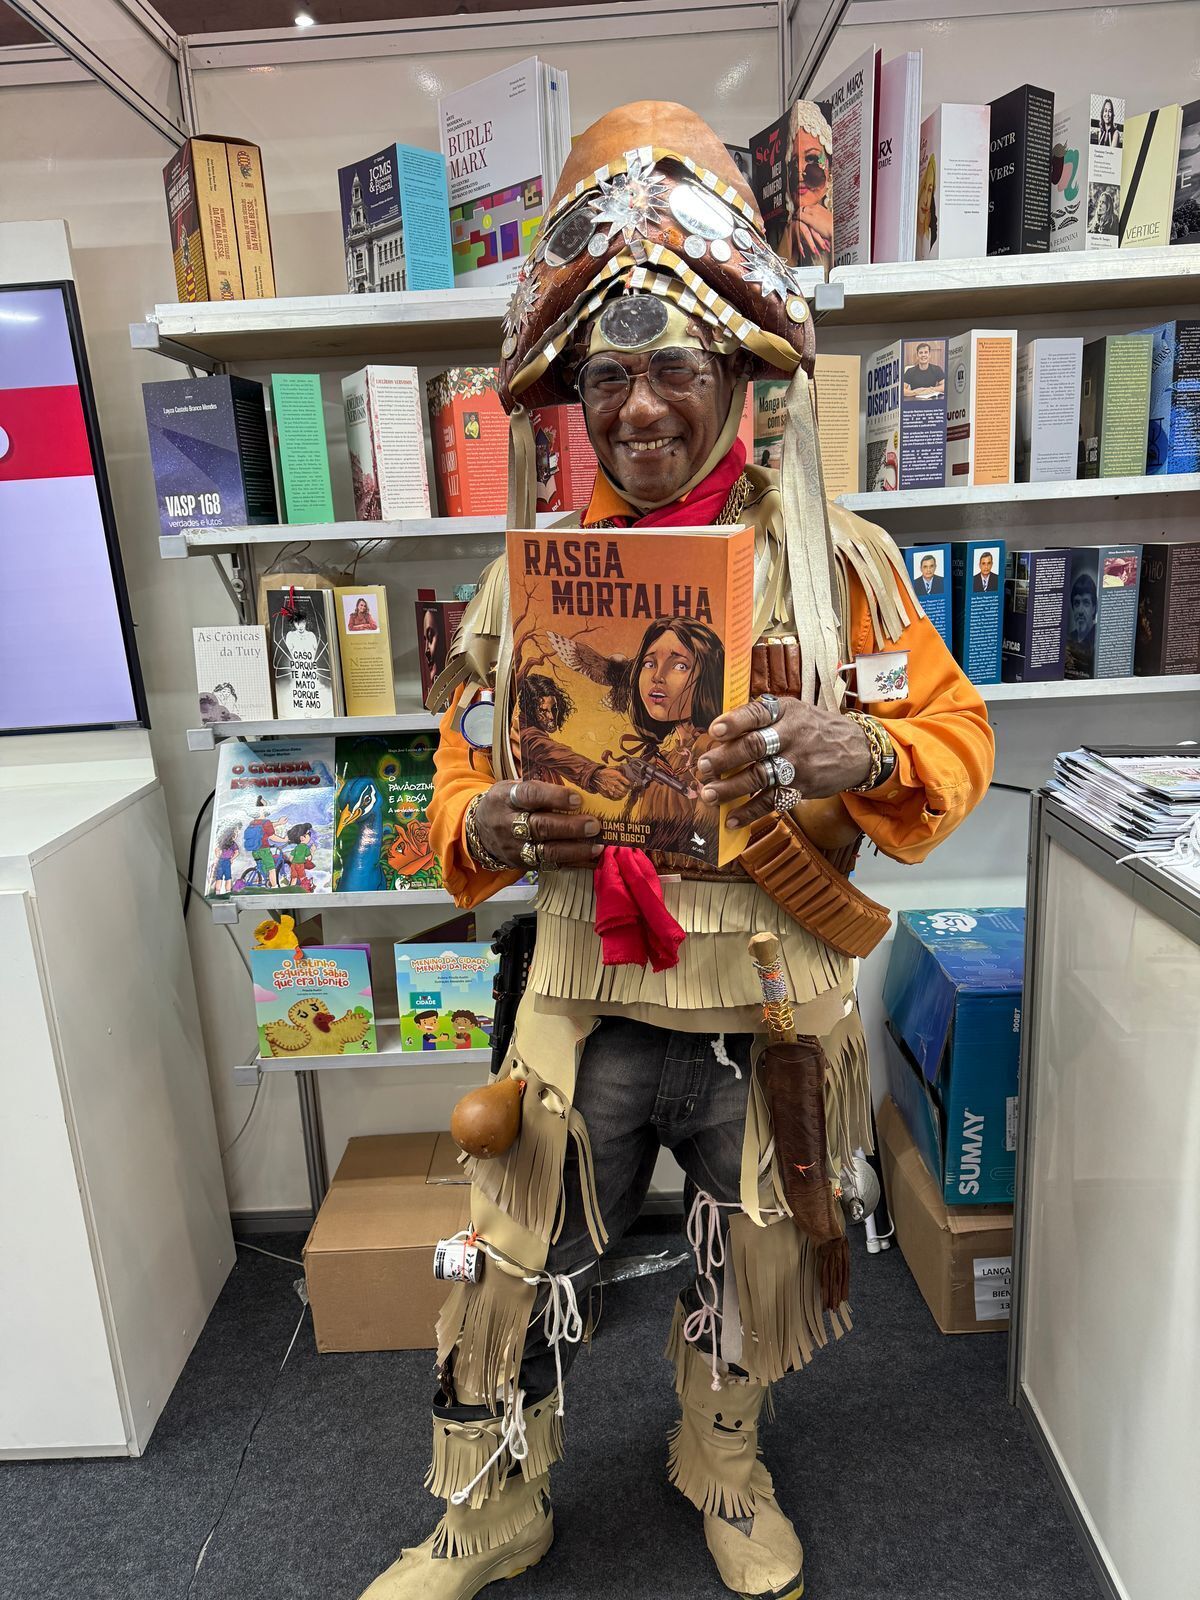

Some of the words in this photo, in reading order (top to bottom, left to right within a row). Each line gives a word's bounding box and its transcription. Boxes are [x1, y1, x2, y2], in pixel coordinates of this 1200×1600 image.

[846, 69, 863, 99] MARX
[448, 121, 493, 157] BURLE
[990, 132, 1015, 153] ONTR
[879, 138, 892, 158] RX
[450, 148, 488, 180] MARX
[879, 156, 892, 169] DADE
[369, 160, 391, 181] ICMS
[990, 163, 1015, 182] VERS
[375, 180, 392, 195] Fiscal
[763, 177, 782, 200] NÚMERO
[988, 201, 994, 213] S
[213, 215, 222, 239] FAMÍLIA
[249, 219, 257, 242] FAMÍLIA
[1126, 222, 1160, 240] VÉRTICE
[252, 242, 259, 251] DA
[949, 346, 963, 357] NHEIRO
[874, 363, 892, 391] PODER
[759, 397, 780, 414] Manga
[947, 408, 966, 421] urora
[768, 415, 780, 429] com
[165, 495, 195, 516] VASP
[198, 493, 221, 515] 168
[169, 520, 200, 528] verdades
[206, 518, 223, 526] lutos
[523, 539, 624, 579] RASGA
[551, 580, 713, 624] MORTALHA
[198, 632, 212, 642] As
[214, 631, 260, 642] Crônicas
[1002, 638, 1020, 652] ÁFICAS
[220, 646, 233, 657] da
[235, 646, 261, 659] Tuty
[293, 651, 312, 660] CASO
[290, 661, 317, 670] PORQUE
[291, 671, 299, 679] TE
[295, 681, 316, 690] MATO
[292, 690, 320, 699] PORQUE
[293, 700, 304, 708] ME
[305, 700, 321, 709] AMO
[232, 764, 245, 774] O
[248, 761, 312, 774] CICLISTA
[230, 774, 321, 790] ESPANTADO
[388, 782, 435, 792] PAVÃOZINH
[389, 795, 395, 803] E
[397, 795, 403, 803] A
[406, 793, 427, 803] ROSA
[627, 823, 650, 834] PINTO
[603, 831, 618, 841] JON
[620, 833, 646, 844] BOSCO
[295, 959, 336, 968] Patinho
[411, 958, 442, 968] MENINO
[274, 968, 319, 979] esquisito
[323, 969, 348, 978] sabia
[274, 980, 293, 989] que
[318, 977, 349, 987] bonito
[959, 1112, 985, 1195] SUMAY
[982, 1267, 1011, 1276] LANÇA
[993, 1290, 1011, 1298] BIEN
